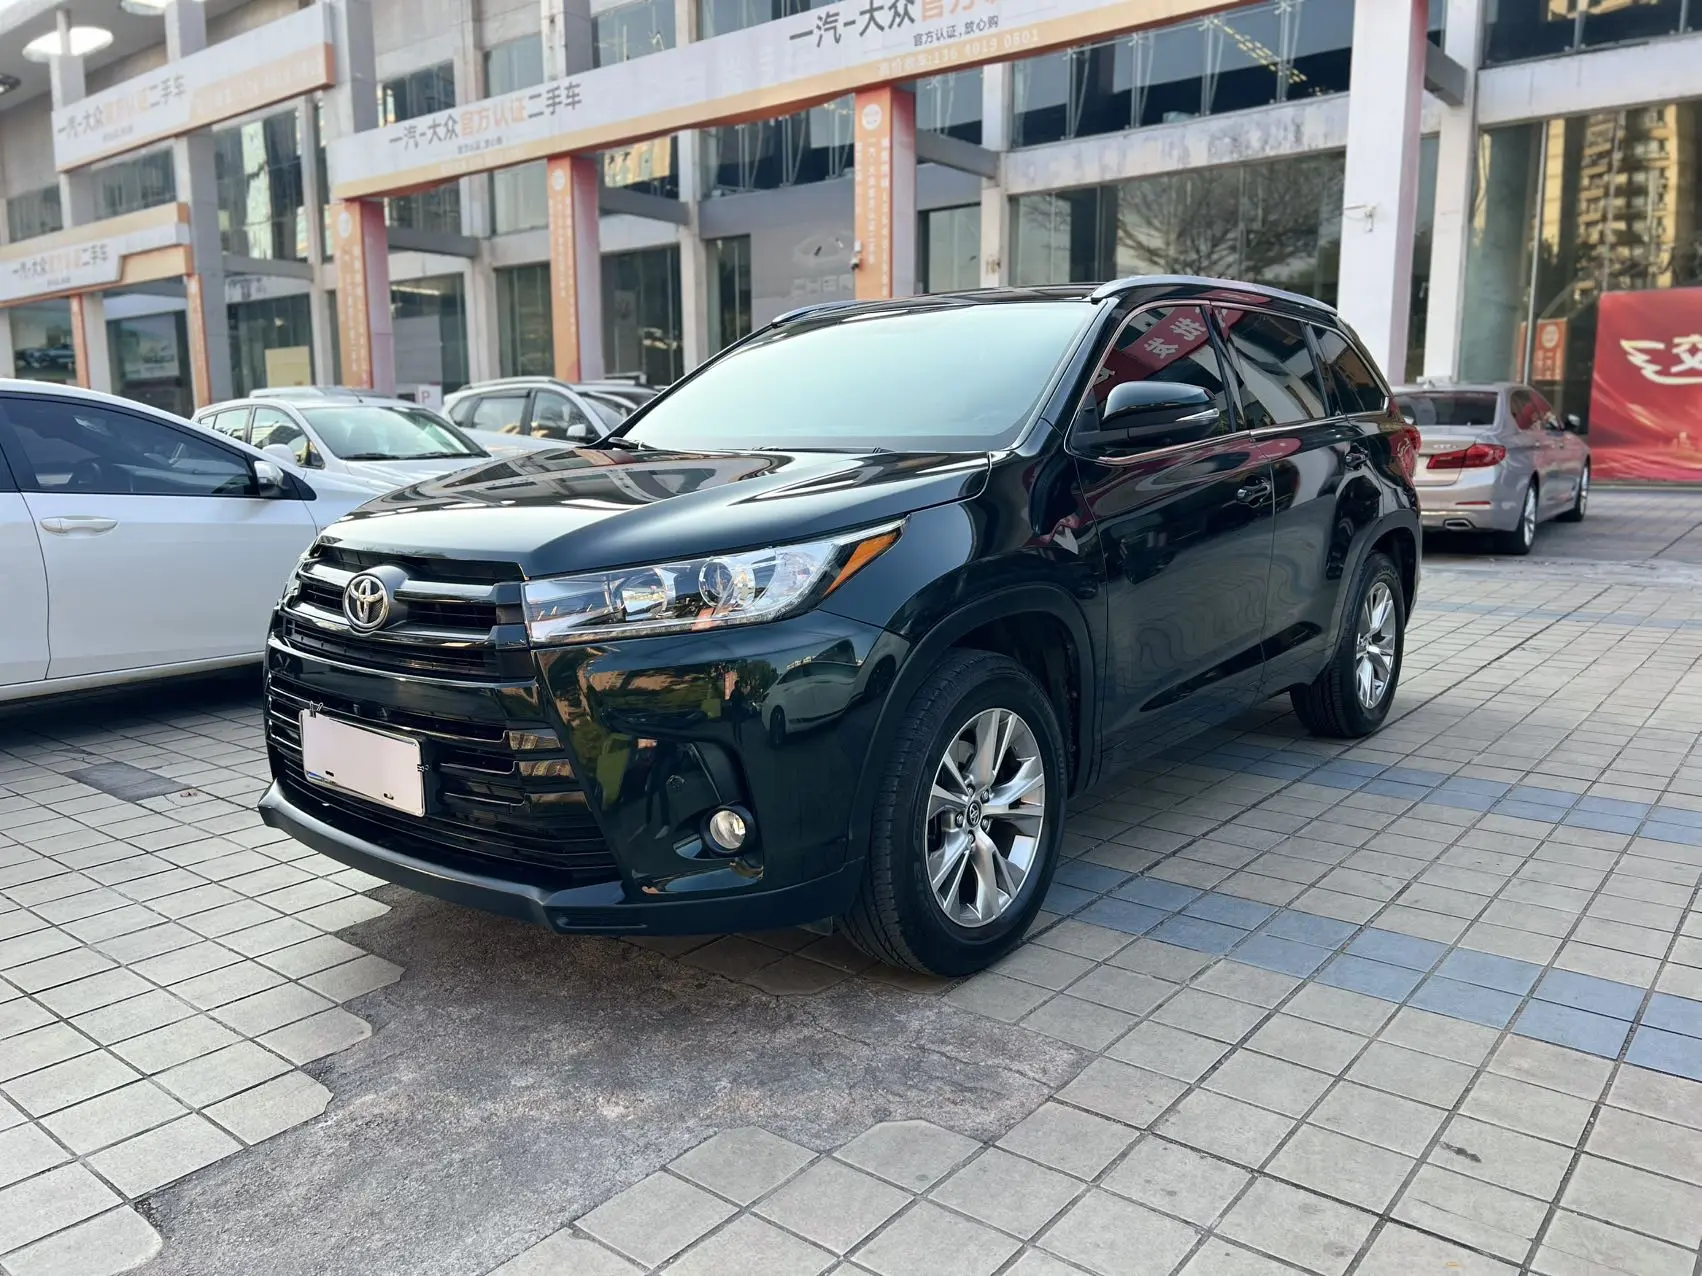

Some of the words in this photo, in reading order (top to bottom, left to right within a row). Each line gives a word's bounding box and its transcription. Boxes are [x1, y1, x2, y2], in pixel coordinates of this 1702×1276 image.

[913, 16, 999, 46] 官方认证，放心购
[389, 82, 582, 150] 一汽-大众官方认证二手车
